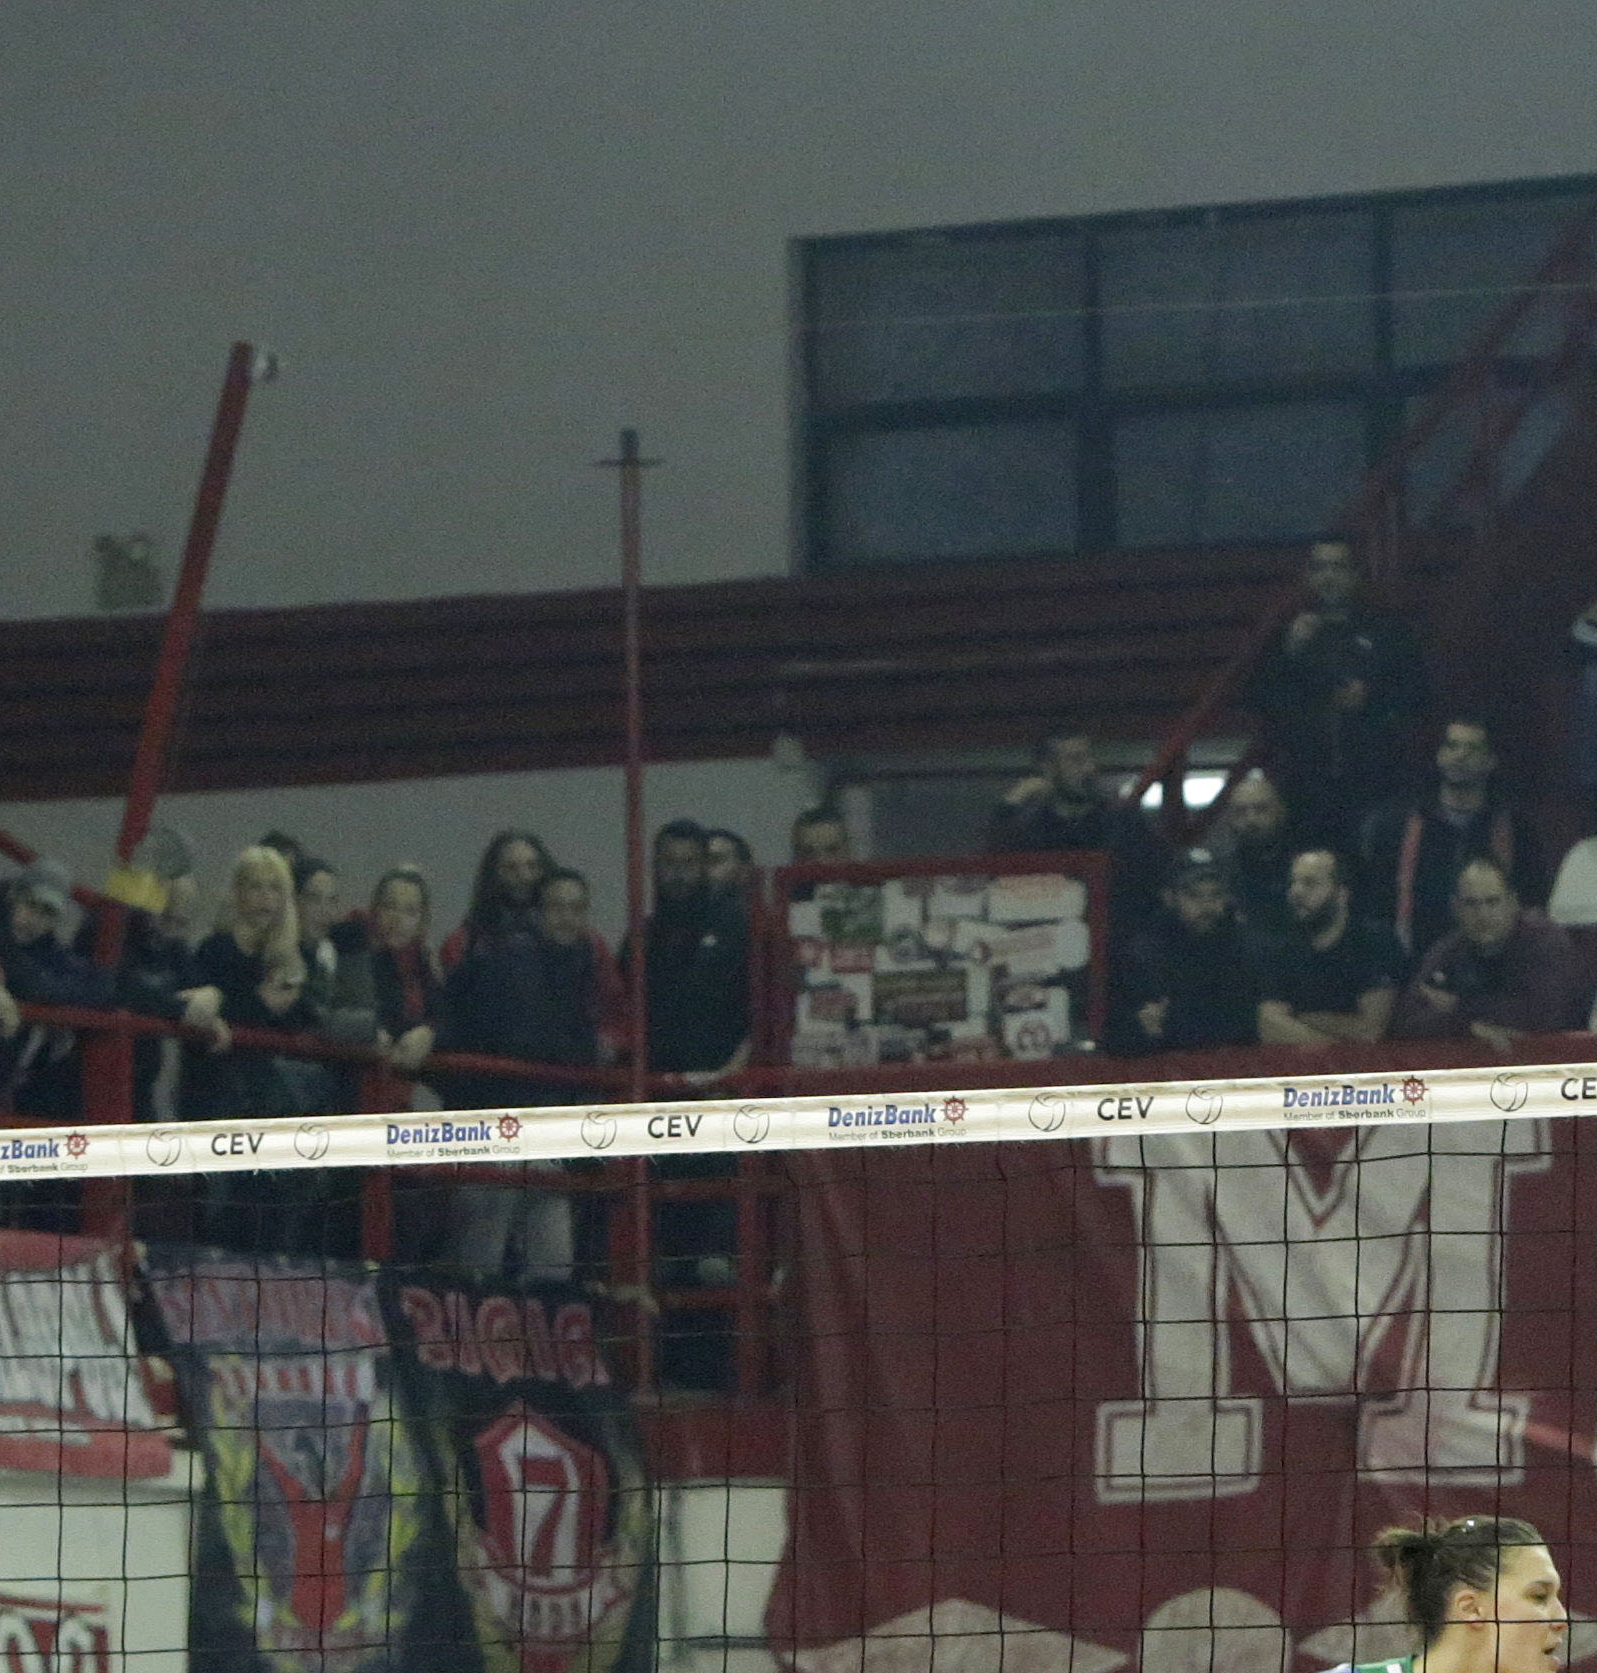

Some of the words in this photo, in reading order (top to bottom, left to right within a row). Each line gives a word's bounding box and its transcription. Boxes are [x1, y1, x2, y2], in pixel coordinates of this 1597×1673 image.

[1283, 1083, 1395, 1108] DenizBank
[828, 1103, 937, 1128] DenizBank
[1096, 1096, 1154, 1121] CEV
[1283, 1111, 1323, 1122] Member
[1325, 1110, 1336, 1120] of
[1337, 1108, 1395, 1120] Sberbank
[1396, 1107, 1427, 1119] Group
[386, 1121, 492, 1145] DenizBank
[647, 1114, 703, 1139] CEV
[828, 1131, 868, 1142] Member
[868, 1131, 879, 1141] of
[881, 1129, 936, 1140] Sberbank
[937, 1127, 967, 1139] Group
[211, 1132, 265, 1156] CEV
[438, 1146, 491, 1157] Sberbank
